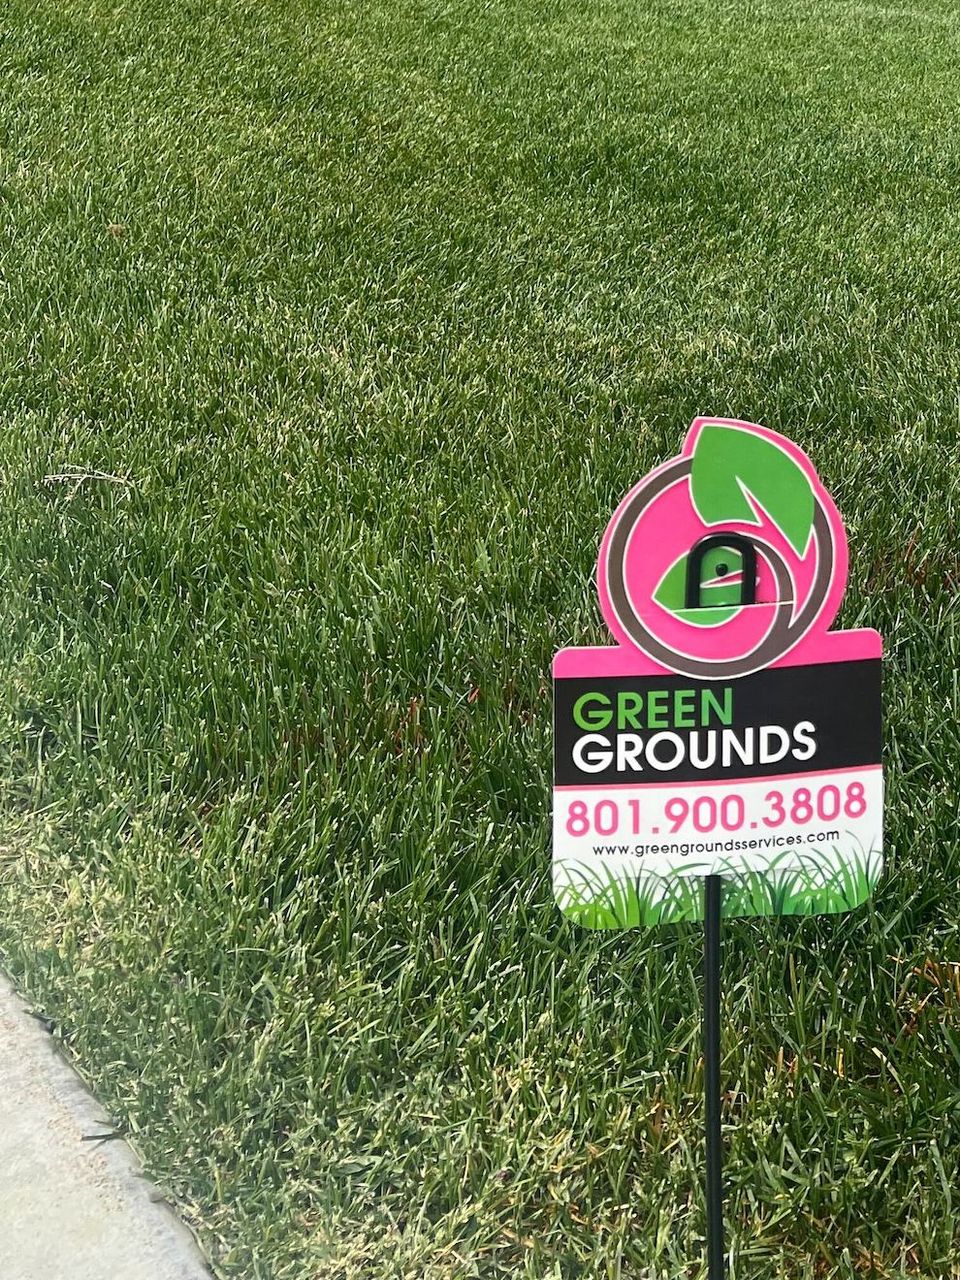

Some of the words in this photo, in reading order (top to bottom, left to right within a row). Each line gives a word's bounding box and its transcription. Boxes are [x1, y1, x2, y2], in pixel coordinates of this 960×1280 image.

[572, 688, 733, 730] GREEN
[572, 721, 817, 773] GROUNDS
[566, 782, 867, 837] 801.900.3808
[592, 830, 840, 857] www.greengroundsservices.com
